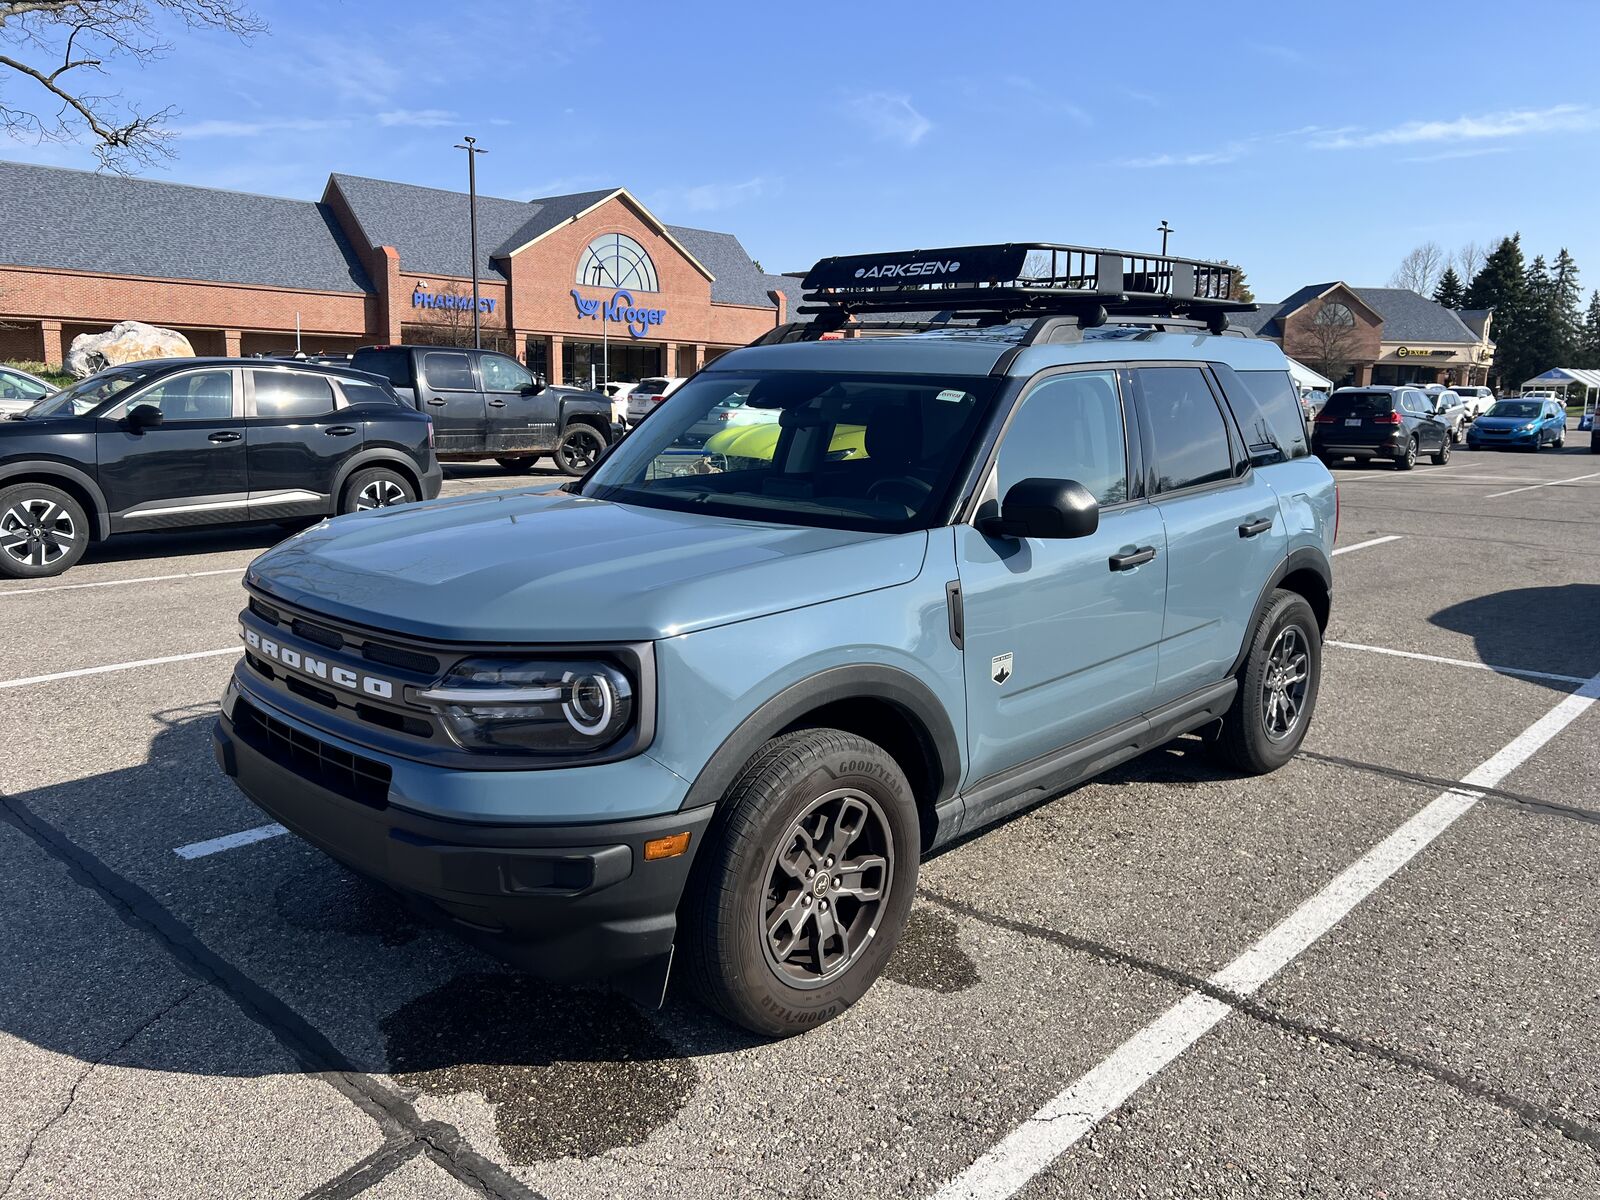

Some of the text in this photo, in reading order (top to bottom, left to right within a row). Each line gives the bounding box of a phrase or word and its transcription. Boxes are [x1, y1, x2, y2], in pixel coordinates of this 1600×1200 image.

[863, 260, 950, 279] ARKSEN
[603, 290, 667, 339] Kroger
[246, 629, 392, 699] BRONCO
[839, 760, 903, 796] GOODYEAR
[761, 995, 837, 1024] GOODYEAR
